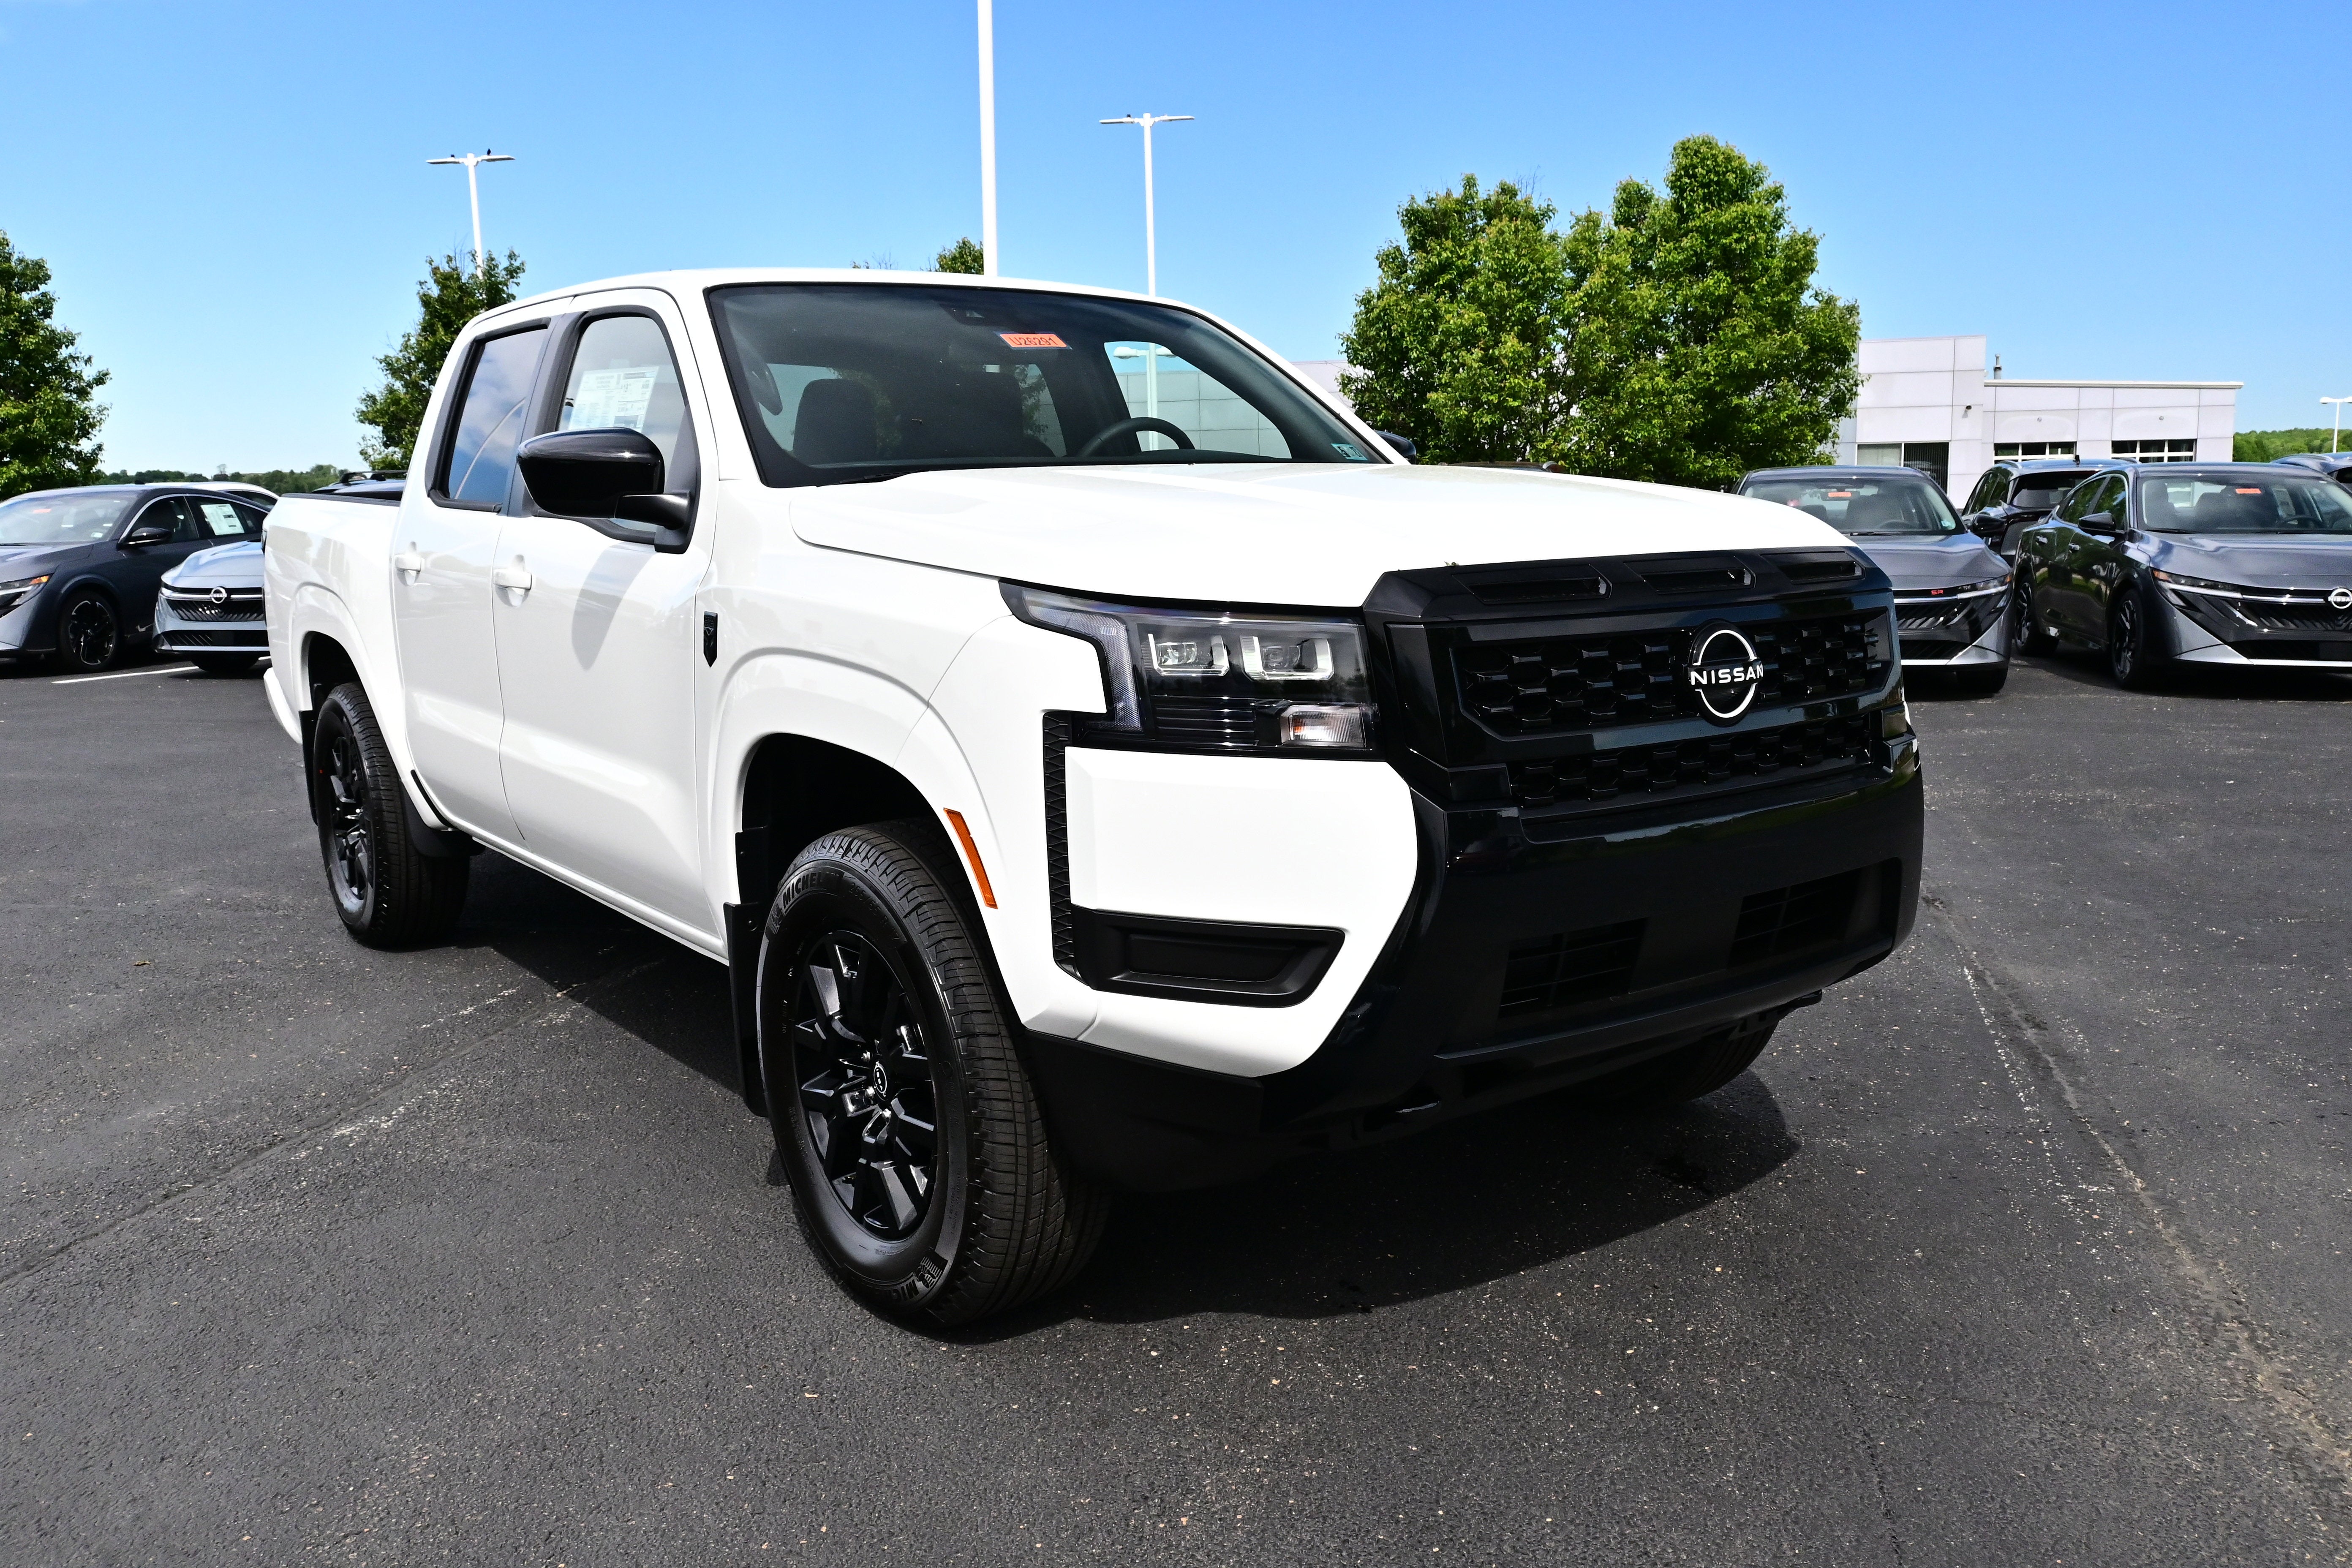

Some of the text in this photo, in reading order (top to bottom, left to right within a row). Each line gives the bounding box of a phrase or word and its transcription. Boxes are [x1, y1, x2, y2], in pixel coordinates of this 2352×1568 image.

[1008, 337, 1058, 346] U26291
[1690, 664, 1764, 685] NISSAN
[782, 871, 841, 909] MICHEL
